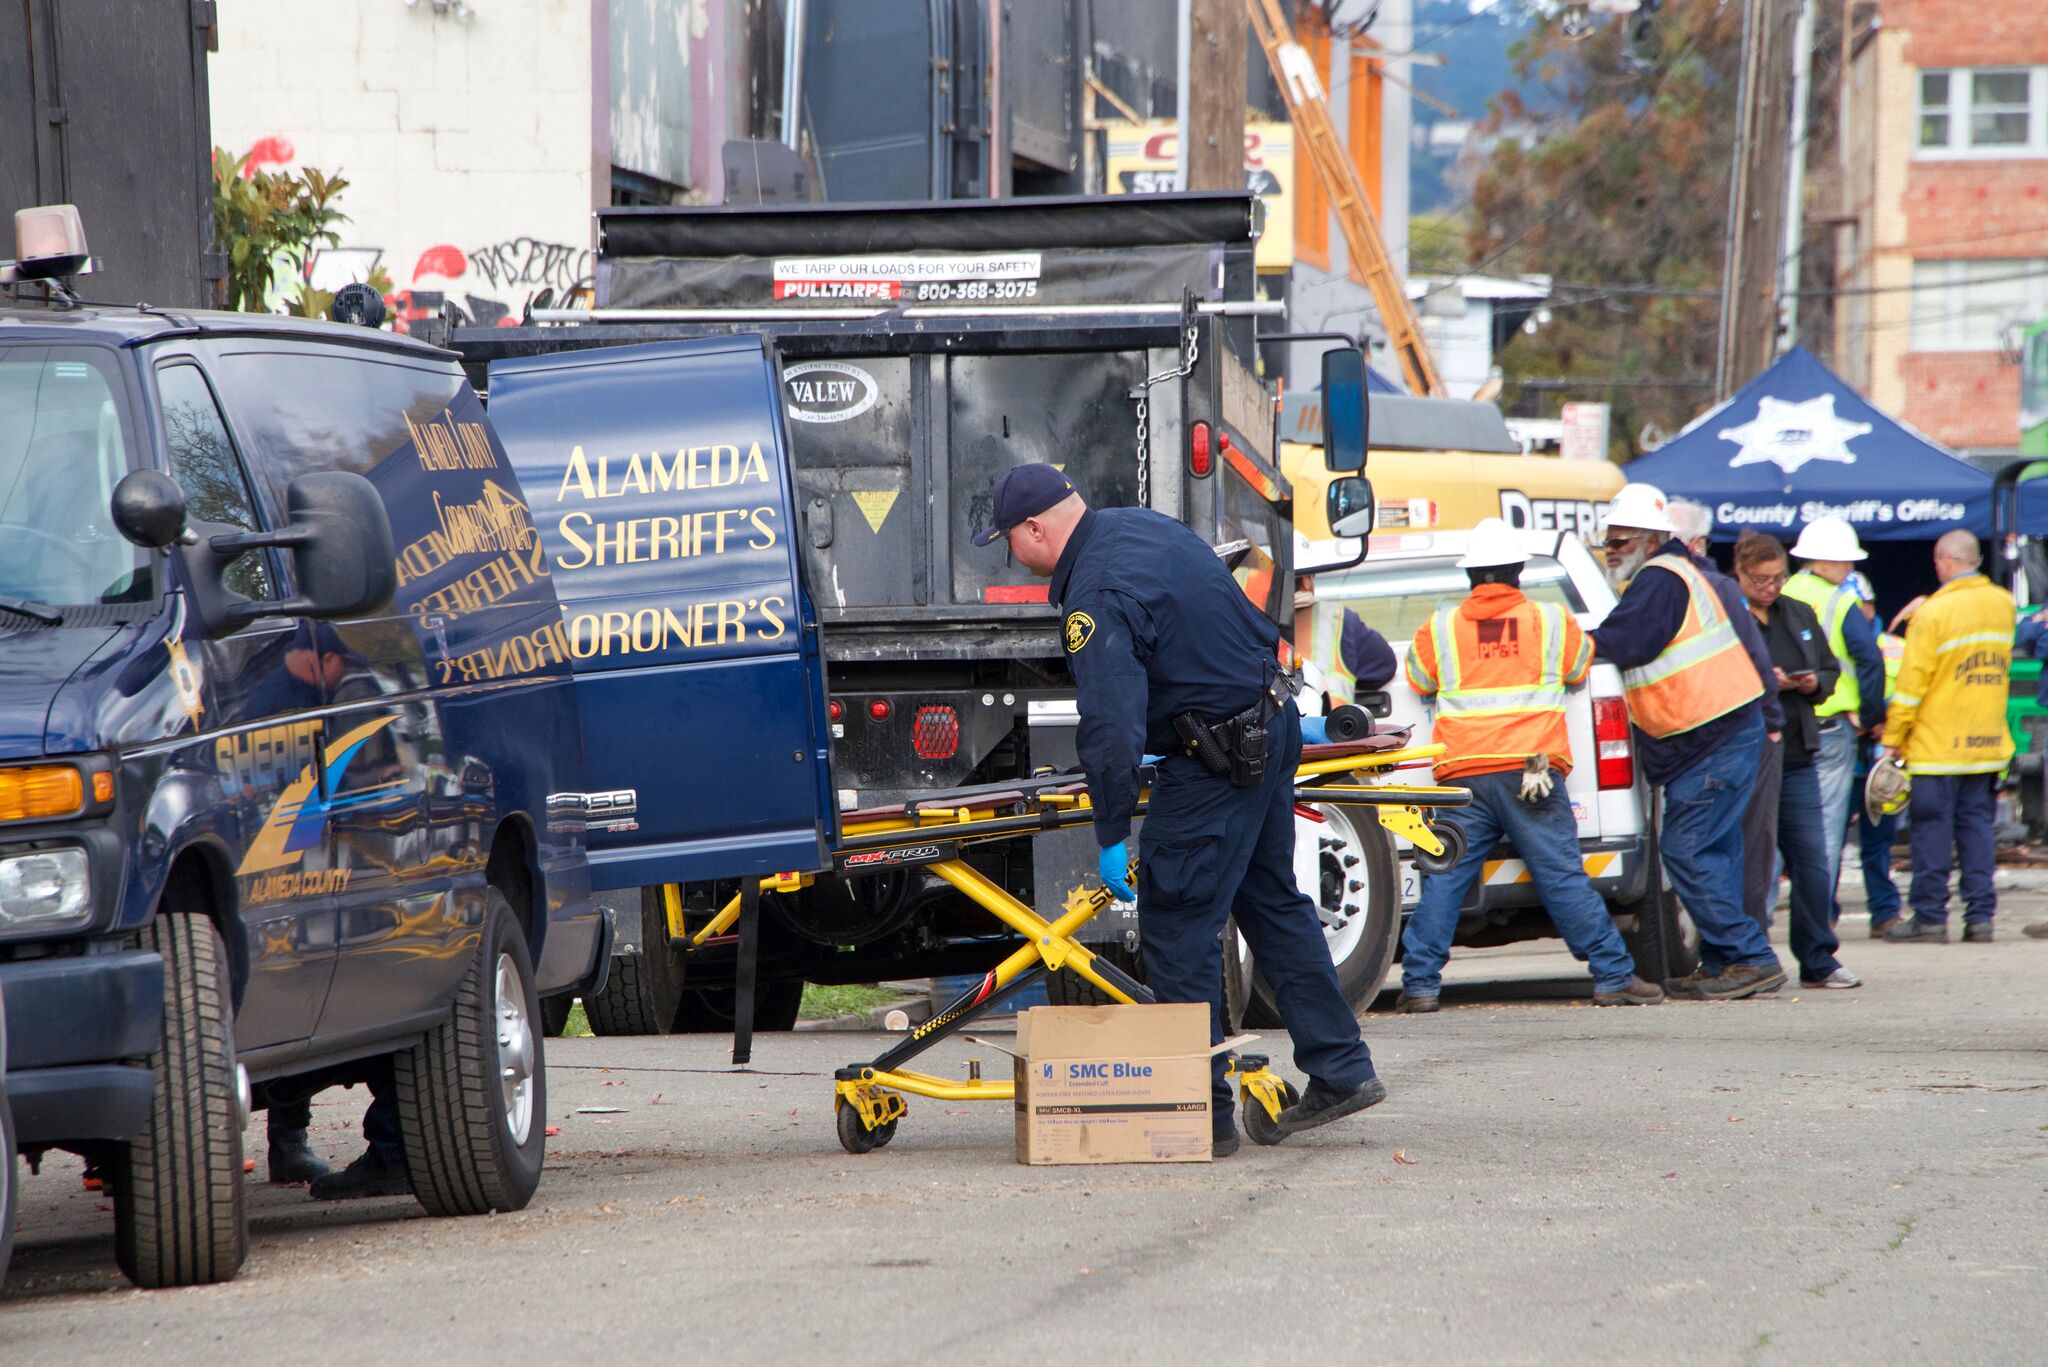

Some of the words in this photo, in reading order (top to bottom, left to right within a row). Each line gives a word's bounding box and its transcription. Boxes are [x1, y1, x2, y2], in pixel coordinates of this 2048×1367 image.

[780, 264, 798, 274] WE
[804, 264, 835, 274] TARP
[839, 264, 868, 274] OUR
[872, 264, 915, 274] LOADS
[919, 263, 945, 273] FOR
[949, 262, 985, 273] YOUR
[988, 261, 1037, 272] SAFETY
[784, 282, 891, 298] PULLTARPS
[917, 282, 1037, 300] 800-368-3075
[790, 381, 857, 403] VALEW
[557, 441, 770, 502] ALAMEDA
[1717, 502, 1797, 527] County
[1799, 500, 1893, 523] Sheriff's
[1896, 498, 1965, 521] Office
[556, 506, 776, 569] SHERIFF'S
[559, 596, 786, 659] ORONER'S
[250, 874, 301, 904] ALAMEDA
[302, 868, 352, 896] COUNTY
[1069, 1063, 1109, 1079] SMC
[1113, 1062, 1153, 1078] Blue
[1176, 1104, 1206, 1112] X-LARGE
